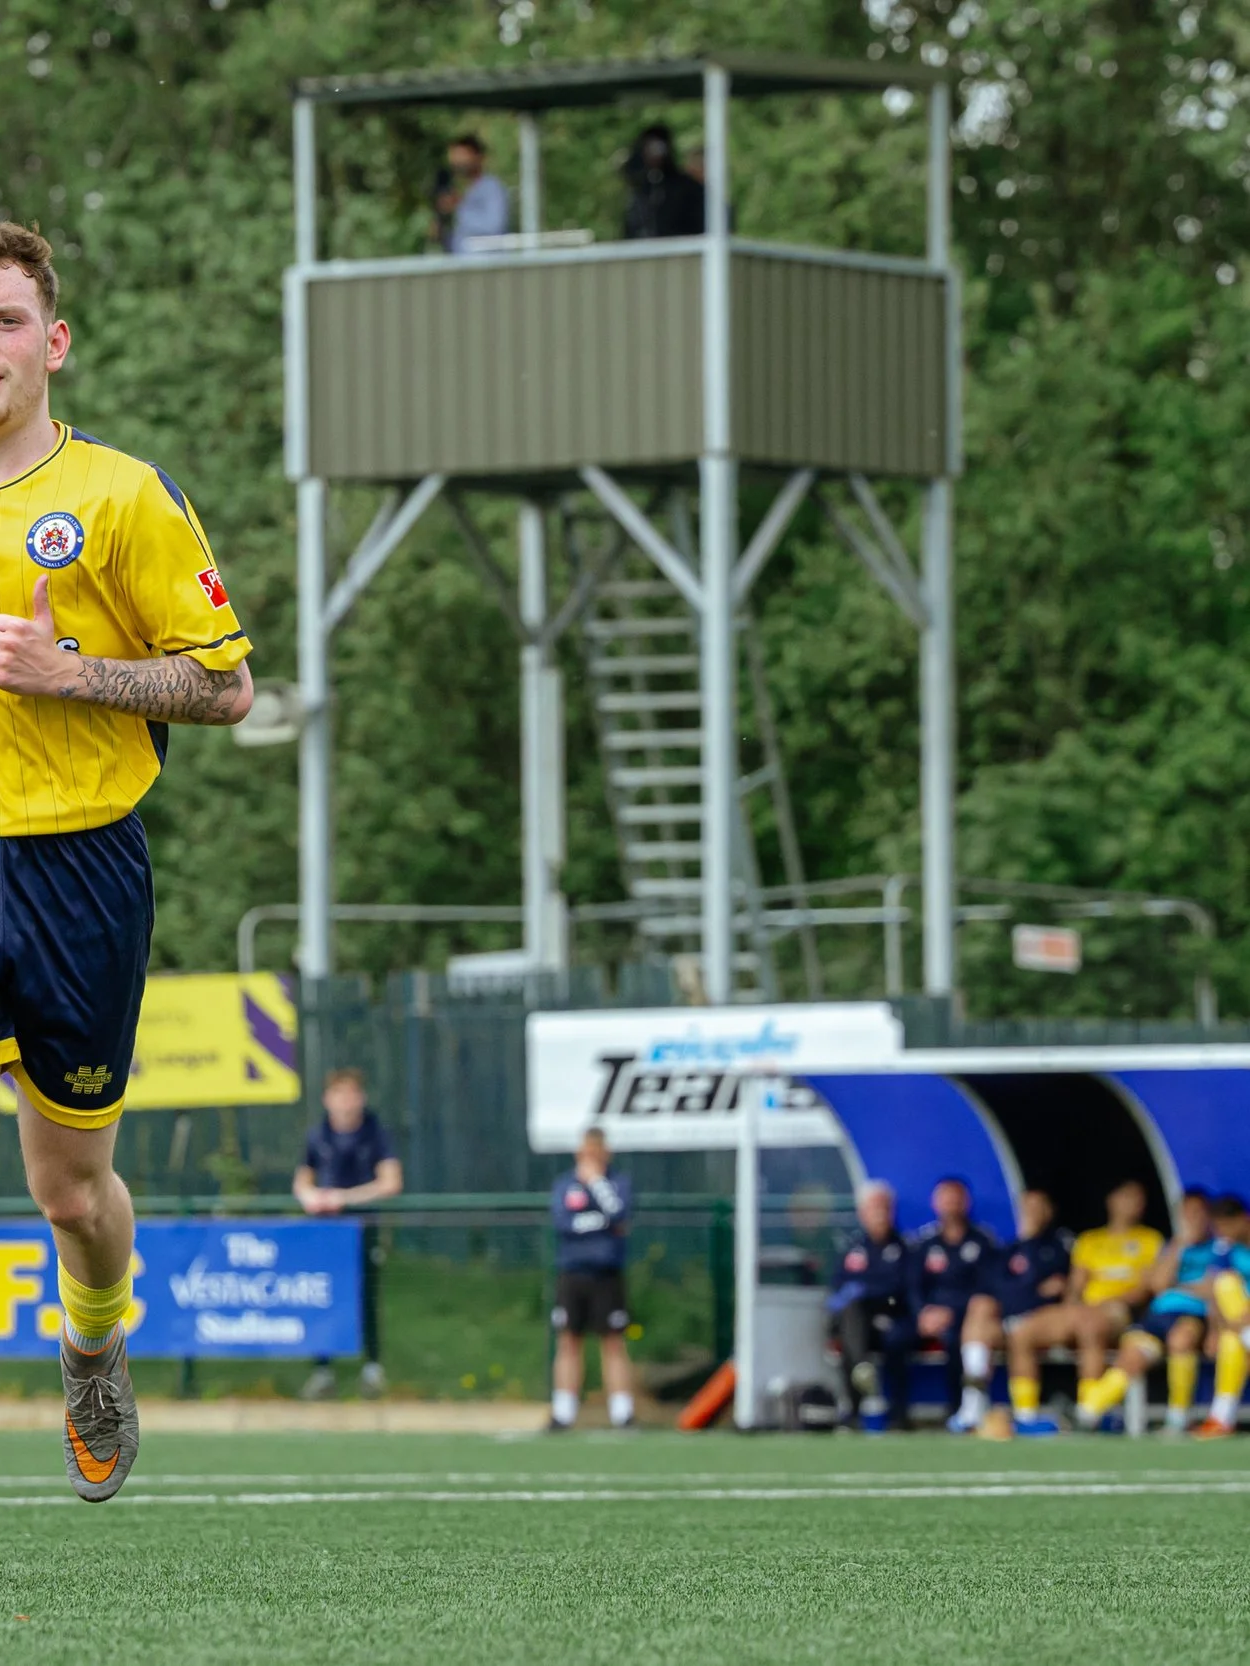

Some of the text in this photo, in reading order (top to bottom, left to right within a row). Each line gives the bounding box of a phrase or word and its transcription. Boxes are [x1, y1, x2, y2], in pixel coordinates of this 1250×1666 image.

[31, 514, 81, 533] STALYBRIDGE CELTIC
[33, 554, 76, 568] FOOTBALL CLUB
[116, 671, 192, 698] Family
[222, 1232, 279, 1267] The
